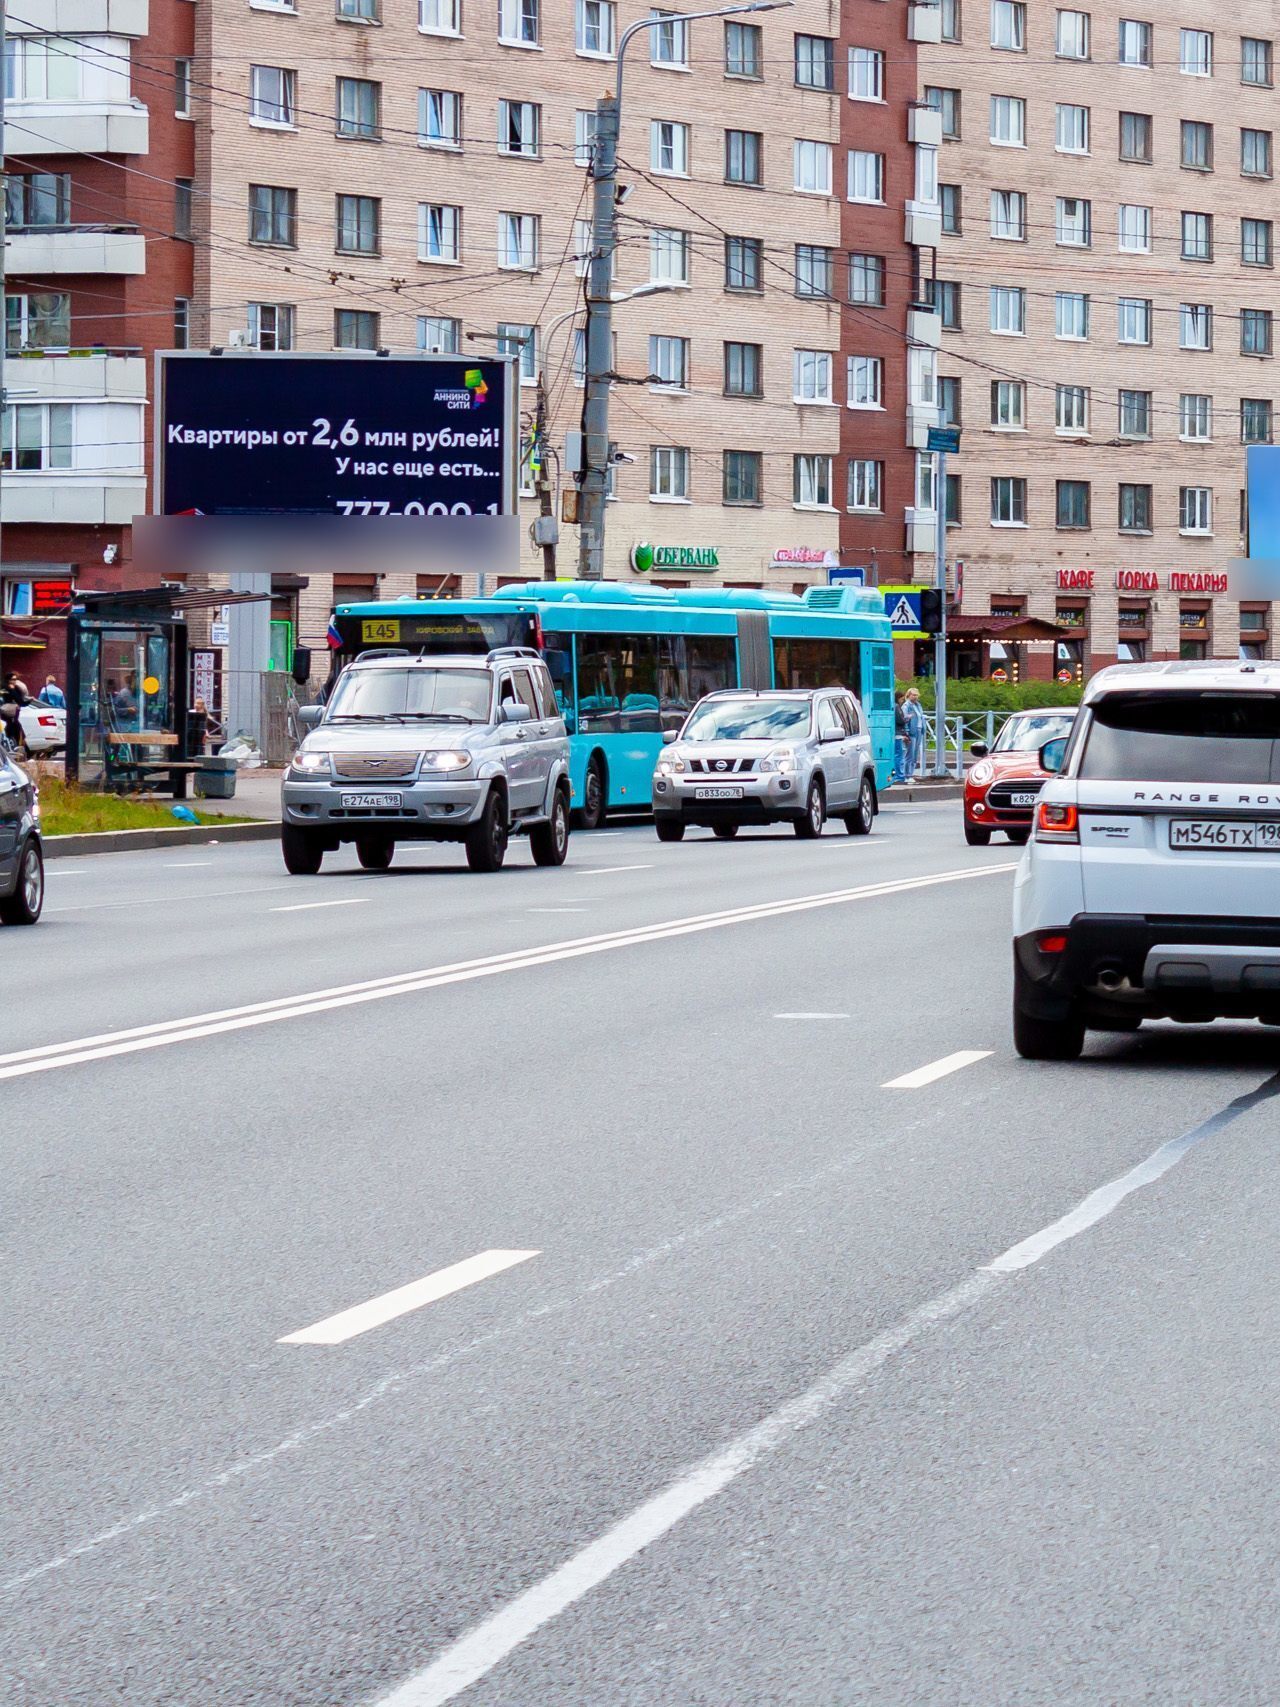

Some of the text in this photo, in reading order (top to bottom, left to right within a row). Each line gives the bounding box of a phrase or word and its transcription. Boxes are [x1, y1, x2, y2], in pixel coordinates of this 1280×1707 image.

[433, 393, 470, 401] АННИНО
[447, 401, 470, 409] СИТИ
[168, 418, 499, 451] Квартиры от 2,6 млн рублей!
[335, 457, 500, 478] У нас еще есть...
[656, 547, 719, 566] СБЕРБАНК
[1058, 569, 1095, 589] КАФЕ
[1117, 571, 1159, 590] ГОРКА
[1169, 572, 1227, 592] ПЕКАРНЯ
[365, 624, 395, 639] 145
[1013, 794, 1036, 803] К829
[1134, 792, 1220, 802] RANGE
